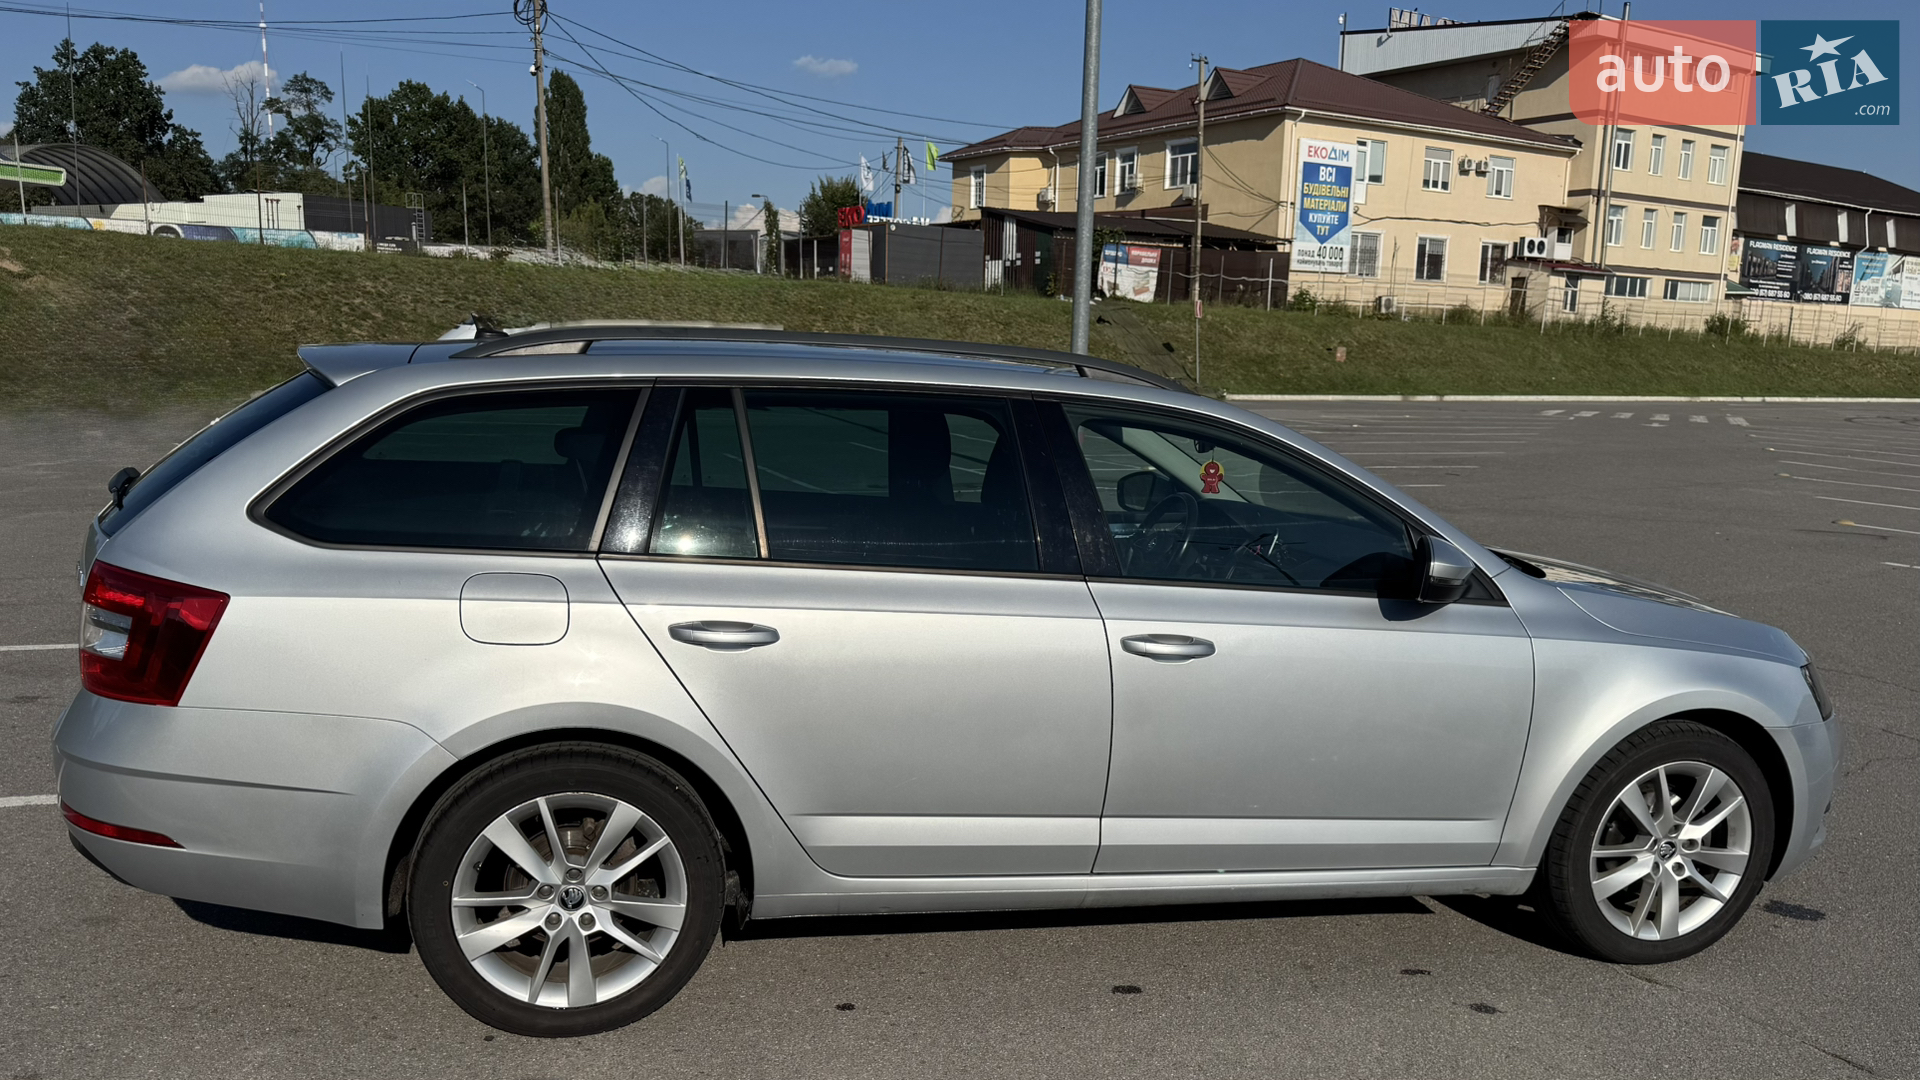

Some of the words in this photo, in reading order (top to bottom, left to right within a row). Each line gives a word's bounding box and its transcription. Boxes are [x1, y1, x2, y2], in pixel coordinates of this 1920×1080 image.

[1307, 145, 1350, 162] ЕКОДІМ
[1319, 166, 1336, 183] ВСІ
[1303, 182, 1349, 198] БУДІВЕЛЬНІ
[1303, 197, 1347, 212] МАТЕРІАЛИ
[1308, 211, 1340, 225] КУПУЙТЕ
[1316, 225, 1330, 236] ТУТ
[1316, 245, 1327, 260] 40
[1328, 246, 1344, 260] 000
